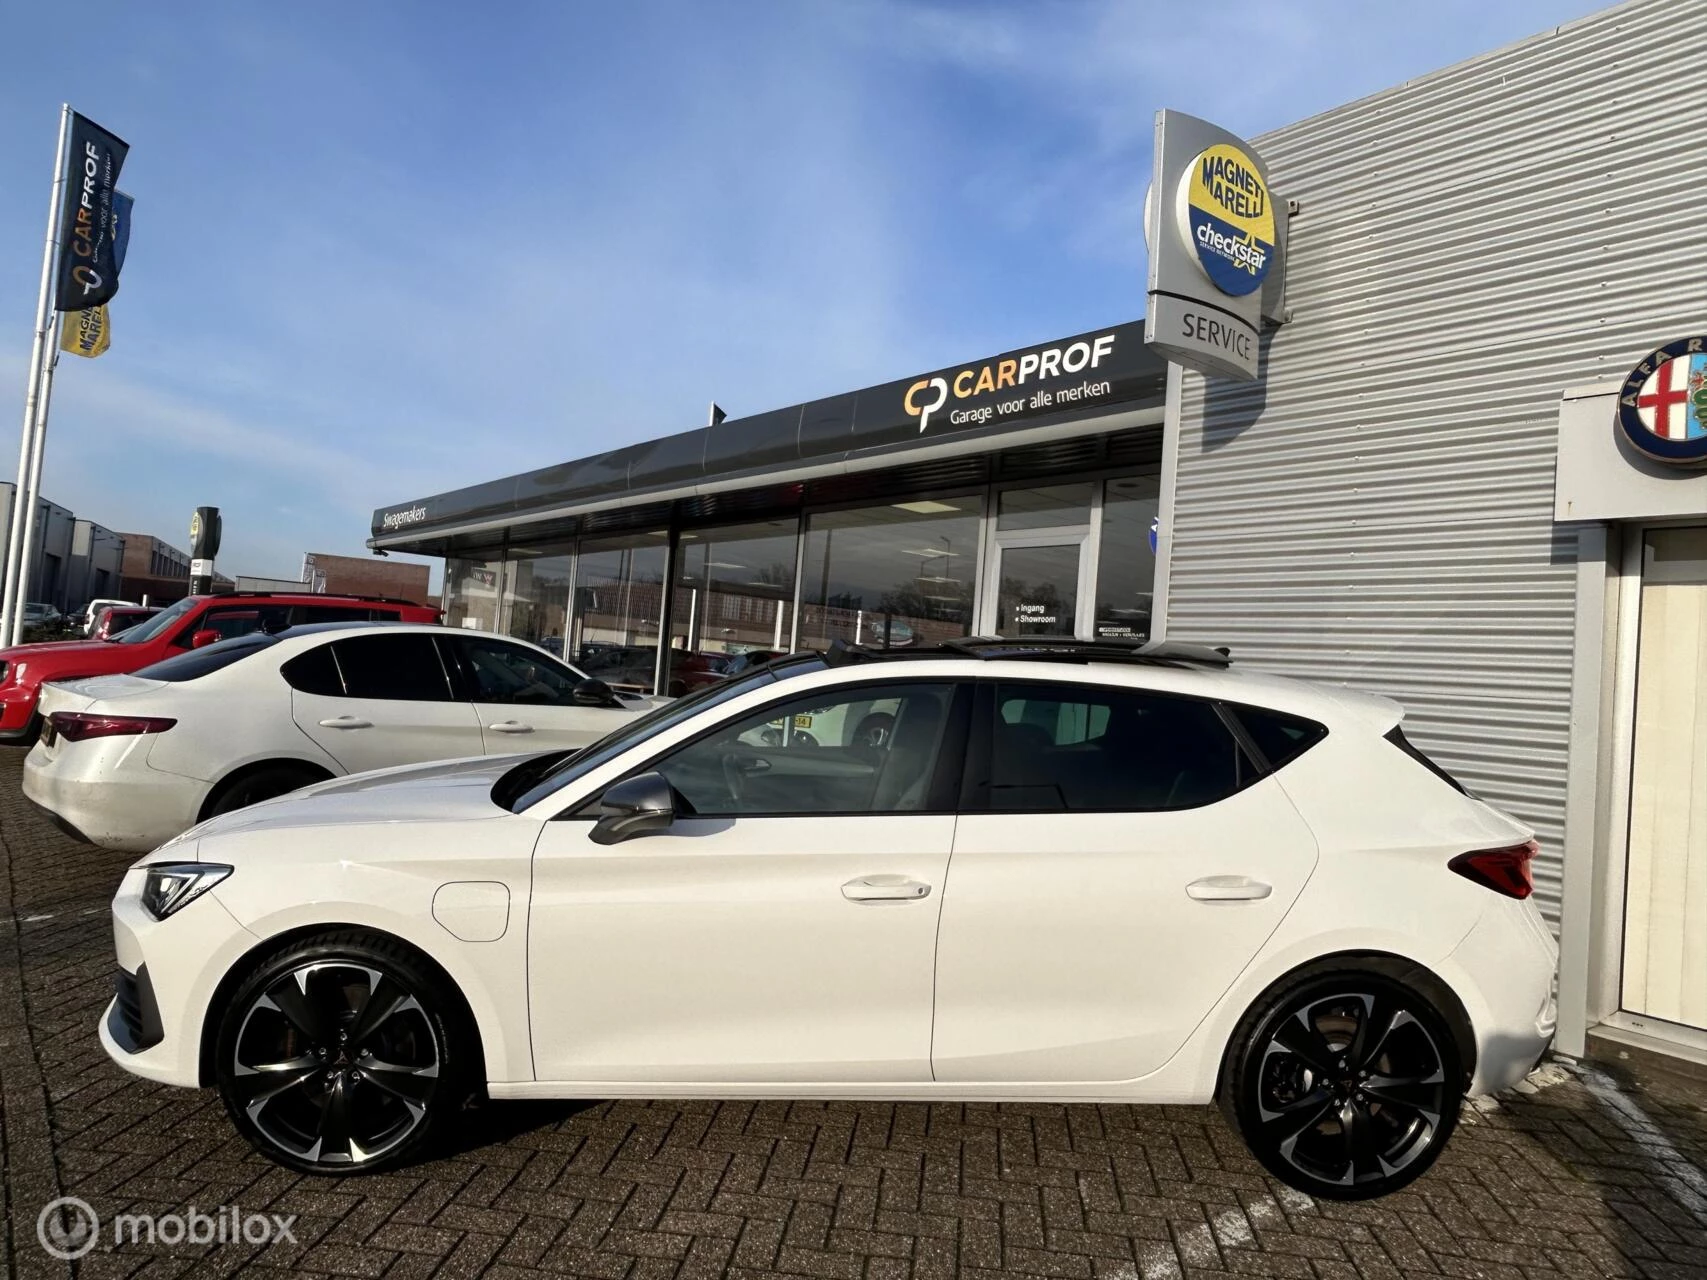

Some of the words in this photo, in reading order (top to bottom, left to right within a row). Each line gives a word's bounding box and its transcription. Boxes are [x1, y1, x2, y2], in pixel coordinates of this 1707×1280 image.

[72, 141, 99, 257] CARPROF
[1202, 156, 1264, 199] MAGNETI
[1202, 172, 1264, 218] MARELLI
[1197, 223, 1266, 268] checkstar
[1182, 313, 1250, 360] SERVICE
[953, 335, 1115, 399] CARPROF
[1621, 350, 1672, 408] ALFA
[950, 406, 992, 424] Garage
[997, 399, 1025, 415] voor
[1030, 390, 1052, 409] alle
[1056, 380, 1111, 404] merken
[383, 505, 427, 529] Swagemakers
[1020, 604, 1045, 614] Ingang
[1020, 615, 1056, 623] Showroom
